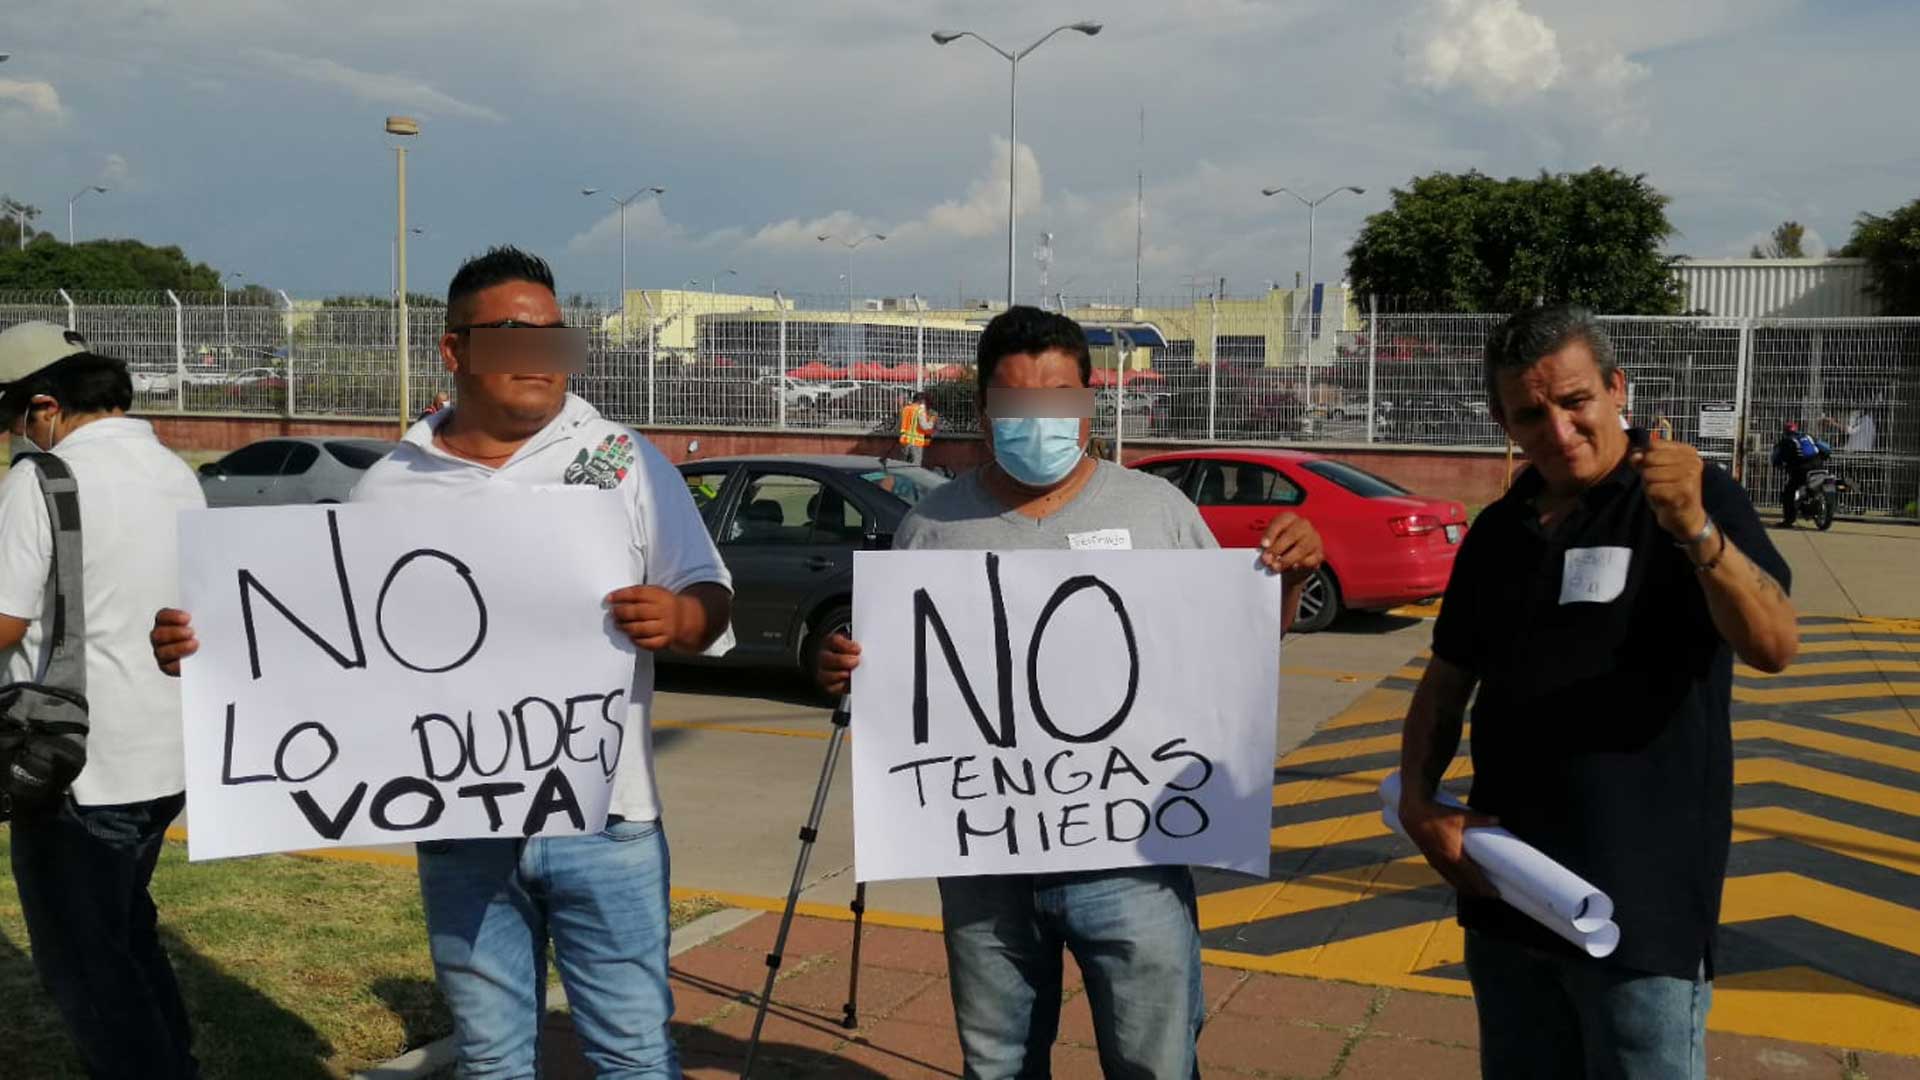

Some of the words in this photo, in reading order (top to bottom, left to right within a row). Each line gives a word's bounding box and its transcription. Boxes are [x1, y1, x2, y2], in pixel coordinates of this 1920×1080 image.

[237, 509, 488, 680] NO
[913, 551, 1140, 749] NO
[222, 703, 340, 786] LO
[411, 687, 626, 783] DUDES
[888, 737, 1214, 808] TENGAS
[289, 765, 586, 841] VOTA
[956, 795, 1211, 857] MIEDO
